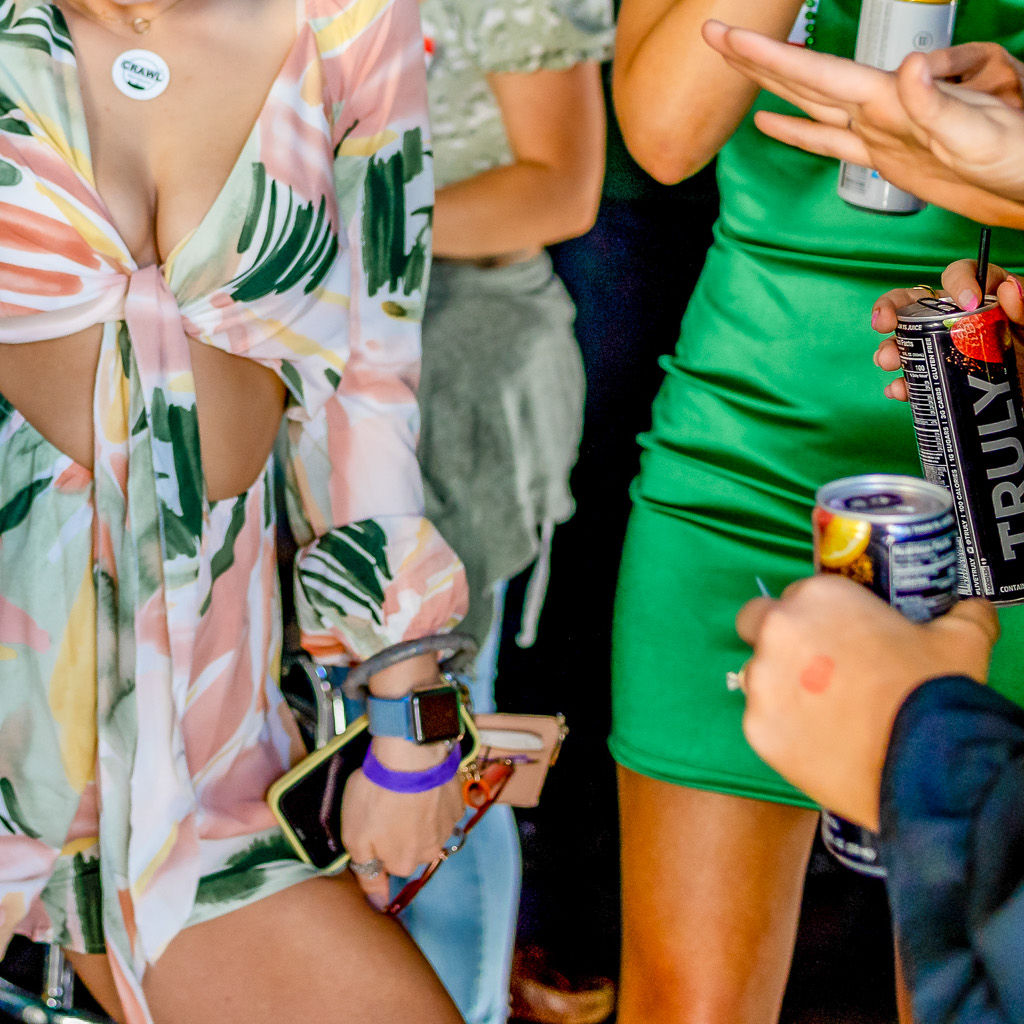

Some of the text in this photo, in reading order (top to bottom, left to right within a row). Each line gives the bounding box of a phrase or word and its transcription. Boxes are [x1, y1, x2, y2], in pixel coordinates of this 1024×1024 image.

[121, 60, 162, 82] CRAWL
[925, 338, 933, 353] FREE
[929, 354, 939, 380] GLUTEN
[967, 374, 1024, 561] TRULY
[952, 469, 963, 500] CALORIES
